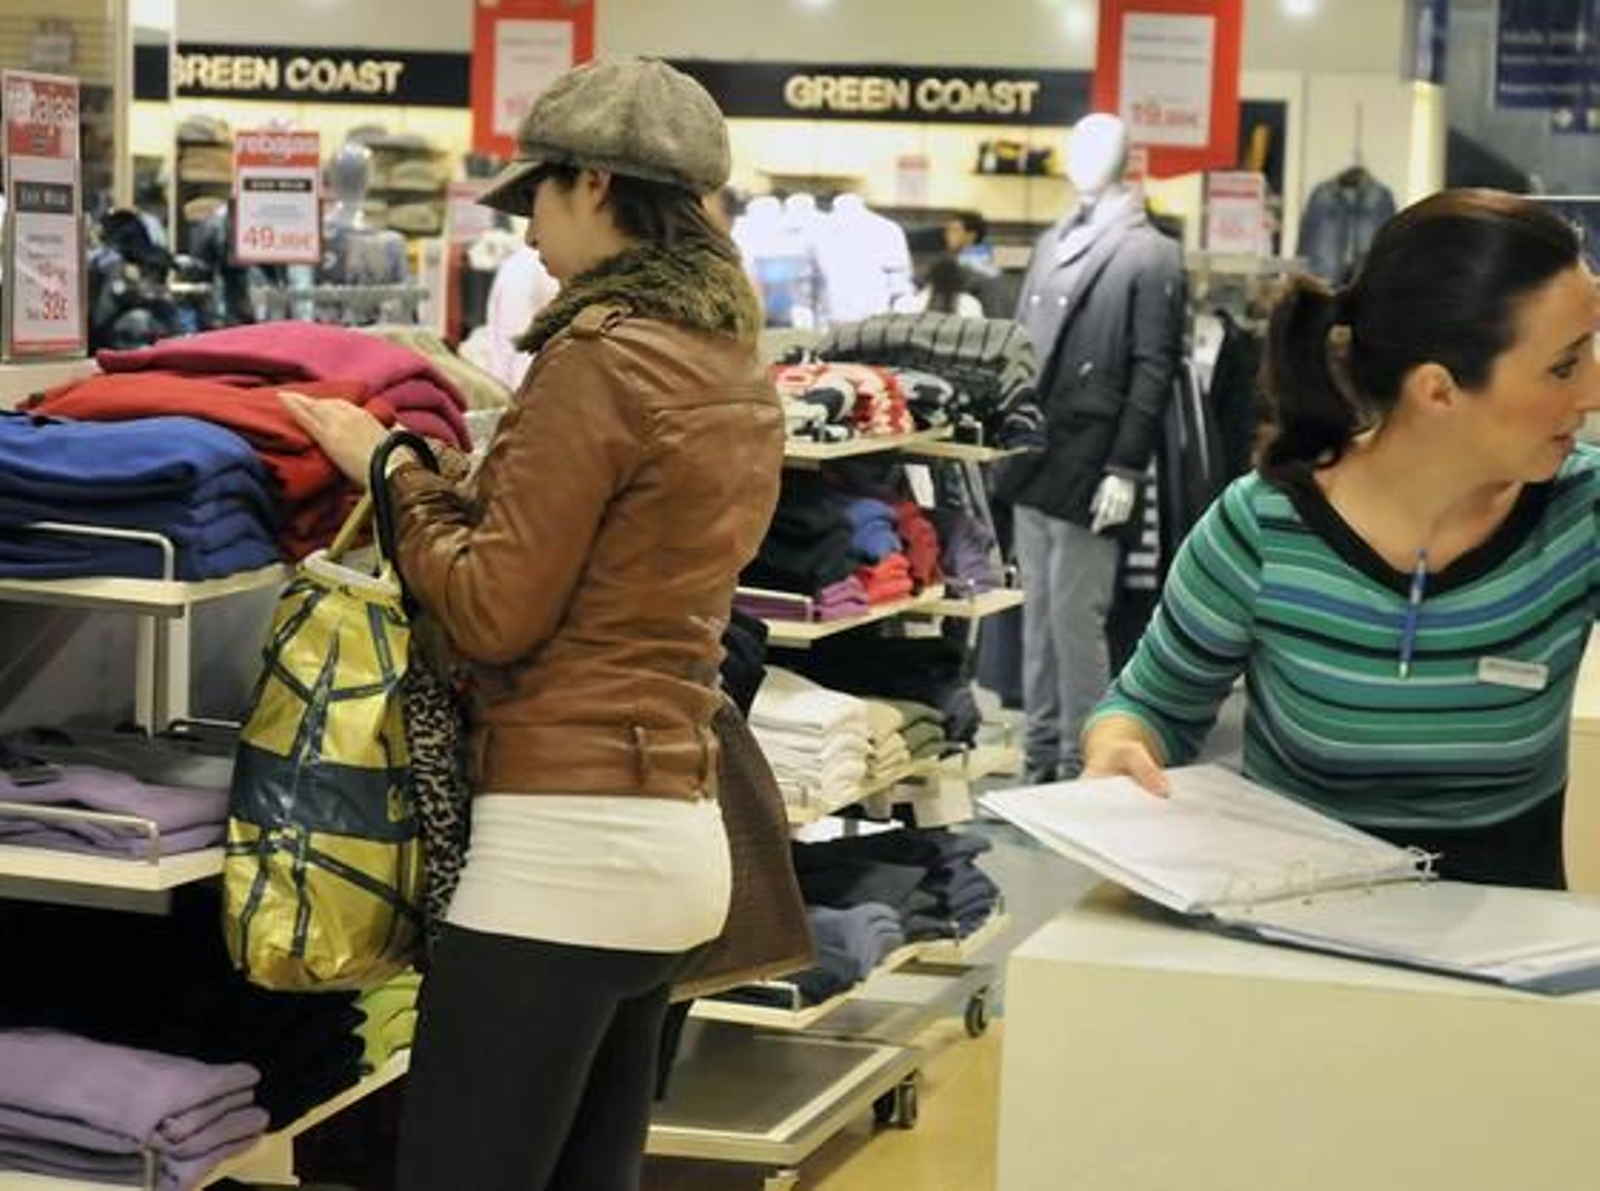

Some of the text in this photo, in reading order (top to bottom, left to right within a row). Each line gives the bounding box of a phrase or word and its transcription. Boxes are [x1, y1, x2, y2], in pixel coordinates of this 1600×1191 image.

[285, 57, 404, 94] COAST
[784, 75, 1039, 114] GREEN COAST
